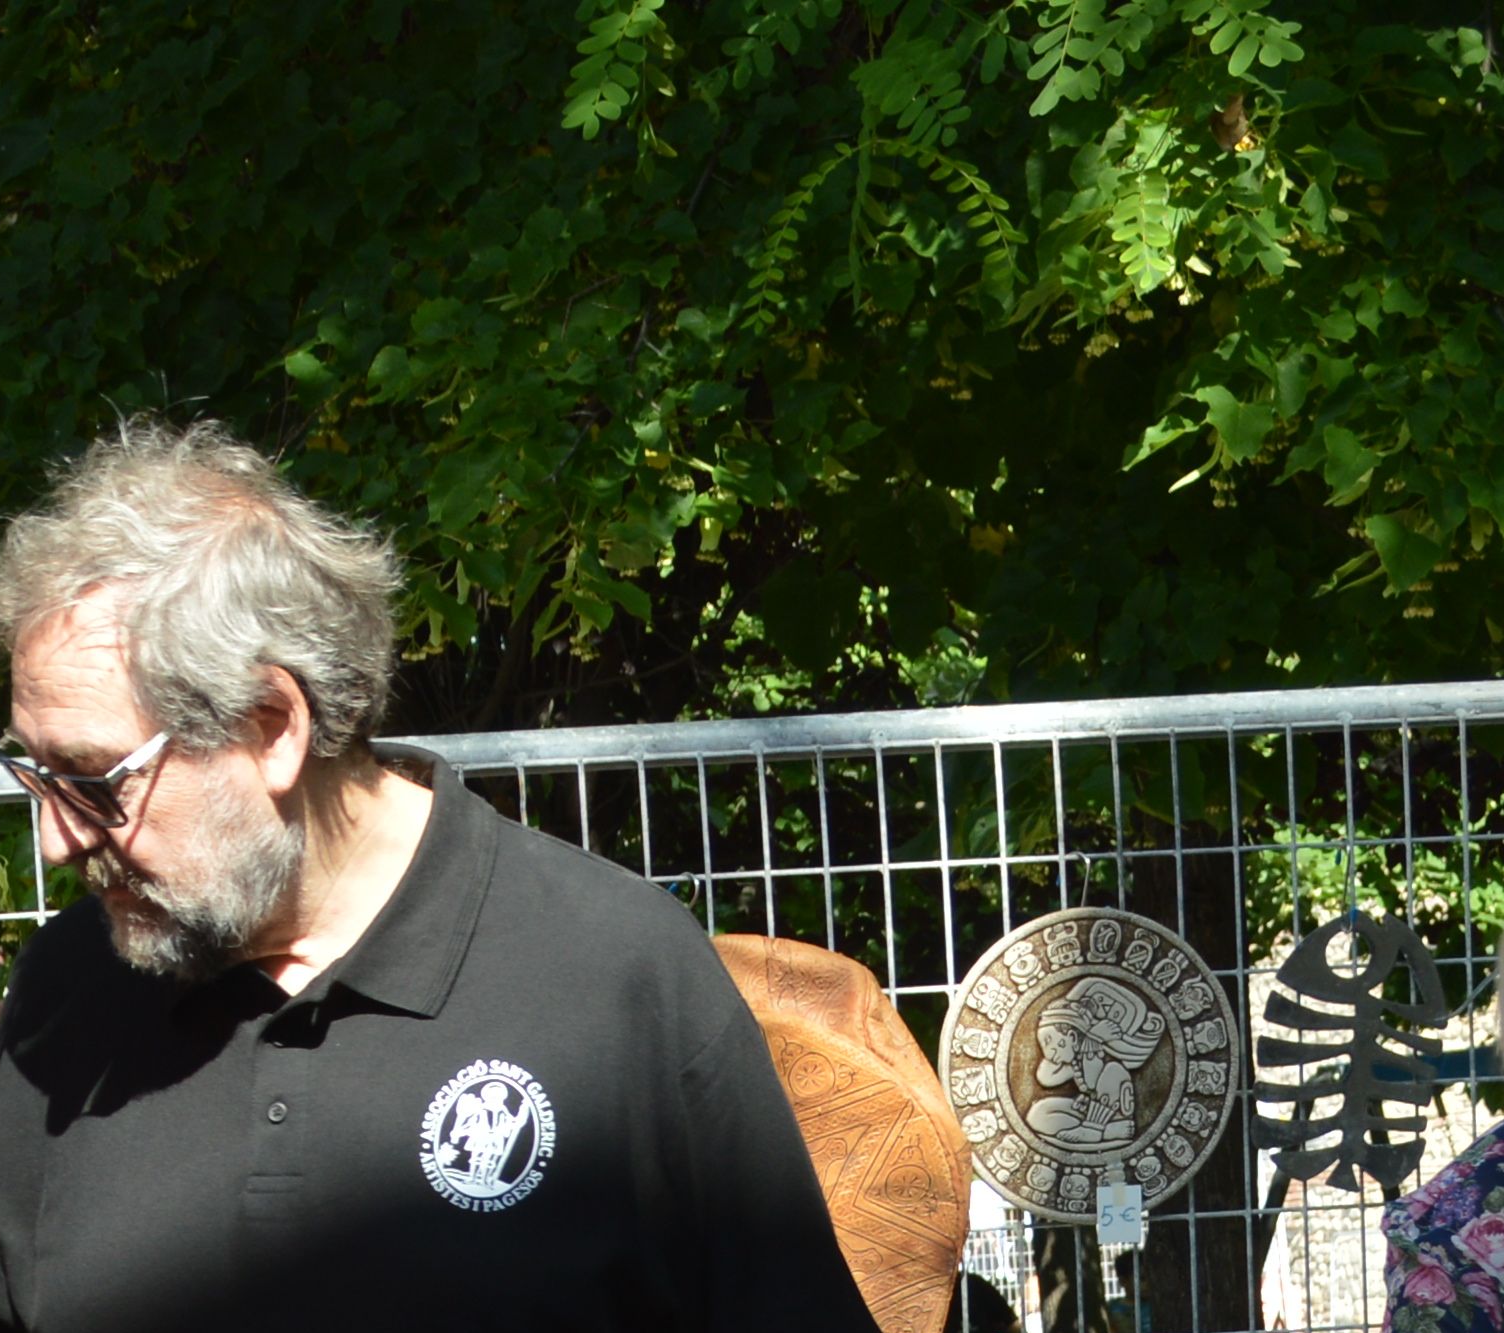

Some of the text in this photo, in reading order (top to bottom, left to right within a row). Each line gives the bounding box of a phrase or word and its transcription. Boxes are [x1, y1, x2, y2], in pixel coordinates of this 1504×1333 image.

[420, 1059, 557, 1158] ASSOCIACIÓ SANT GALDERIC
[419, 1152, 544, 1212] ARTISTES I PAGESOS
